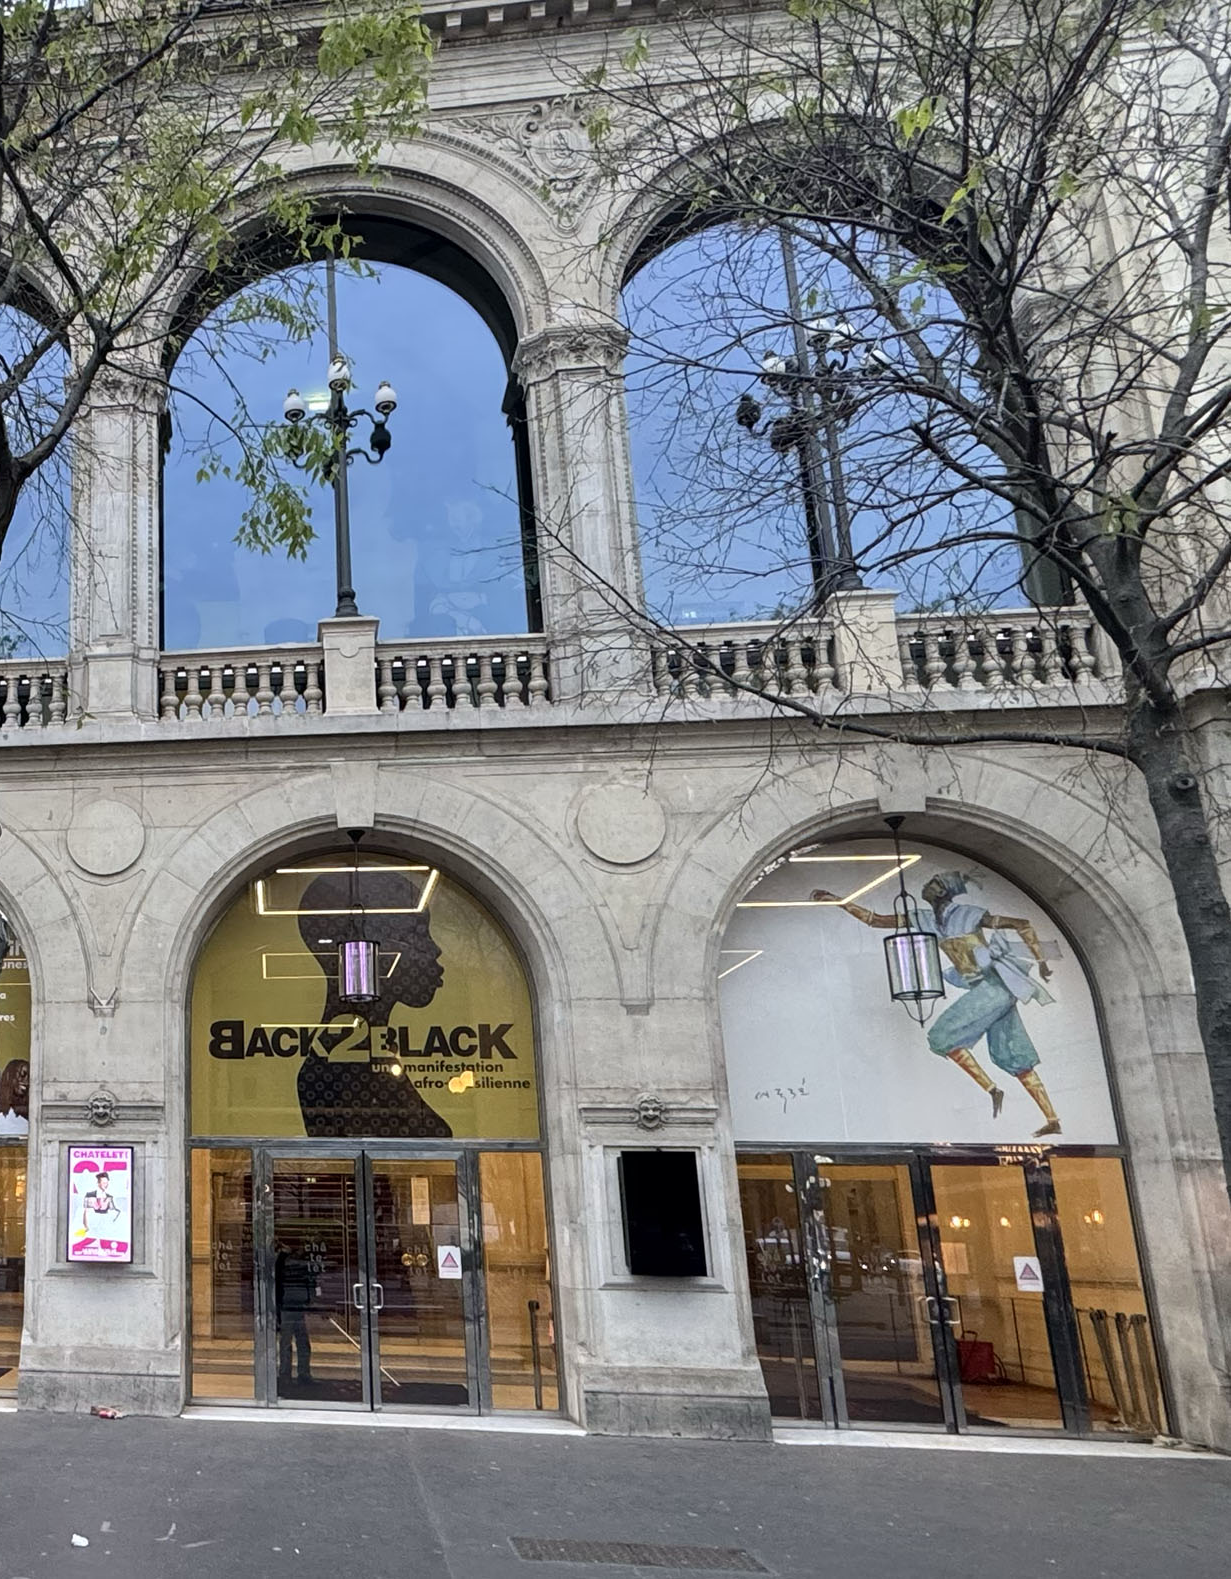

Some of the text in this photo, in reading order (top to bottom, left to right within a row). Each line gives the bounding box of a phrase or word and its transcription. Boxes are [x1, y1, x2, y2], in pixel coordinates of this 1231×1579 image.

[208, 1012, 518, 1063] BACK2BLACK
[371, 1060, 504, 1073] un manifestation
[413, 1076, 531, 1090] afro-silienne
